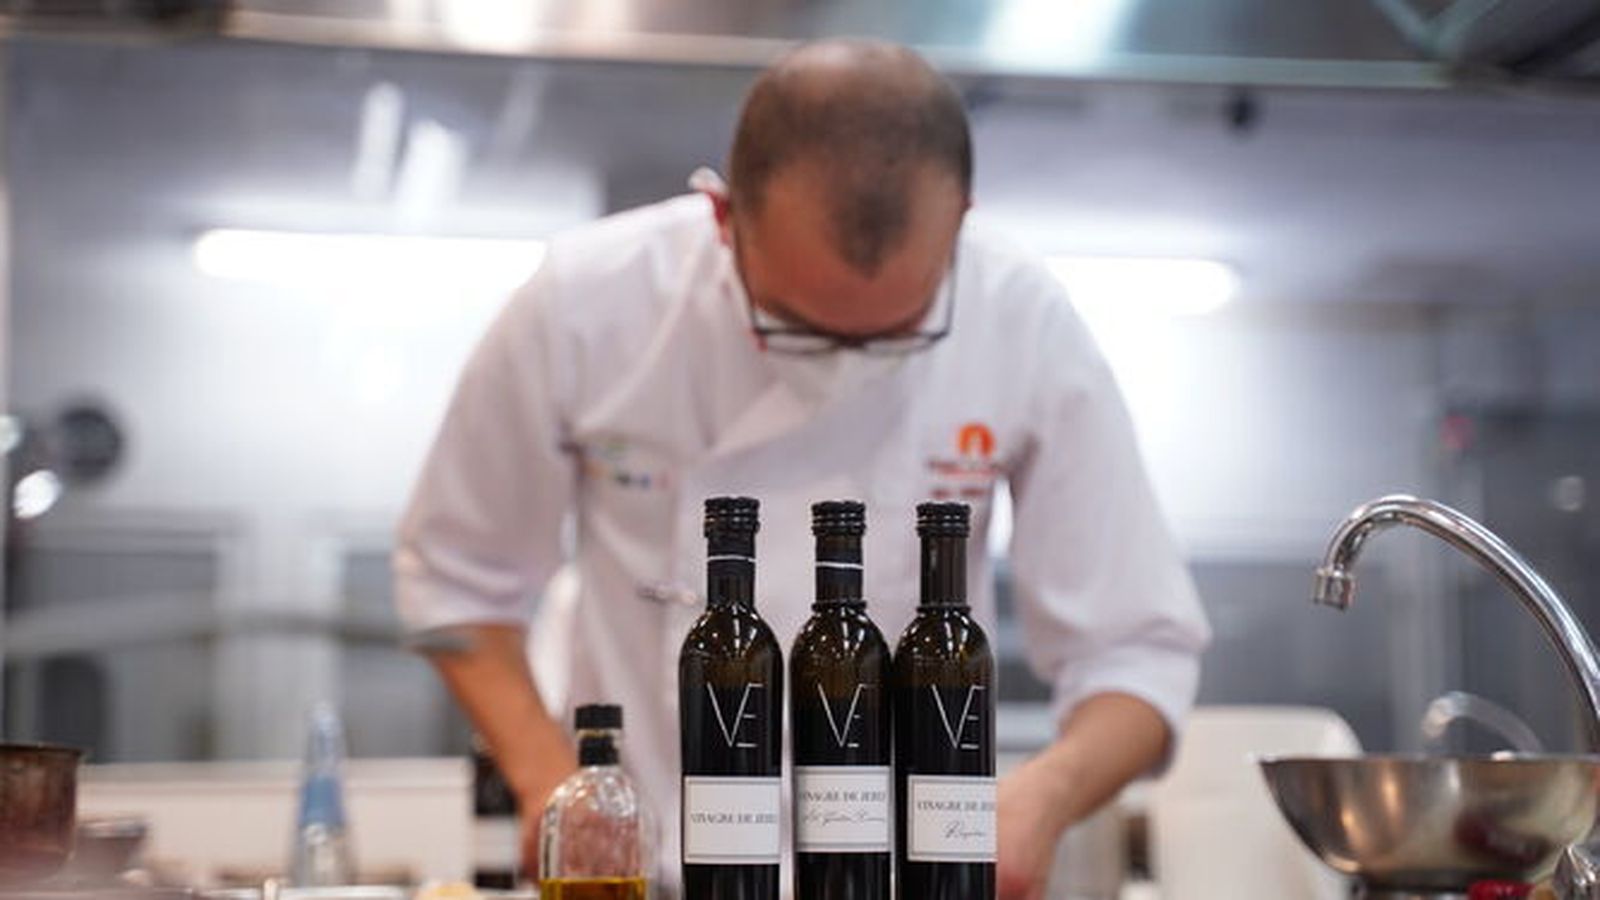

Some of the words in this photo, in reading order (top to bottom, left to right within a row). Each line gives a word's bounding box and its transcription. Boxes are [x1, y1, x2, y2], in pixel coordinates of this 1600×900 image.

[843, 791, 857, 802] DE
[917, 801, 960, 812] VINAGRE
[691, 813, 733, 824] VINAGRE
[737, 813, 752, 824] DE
